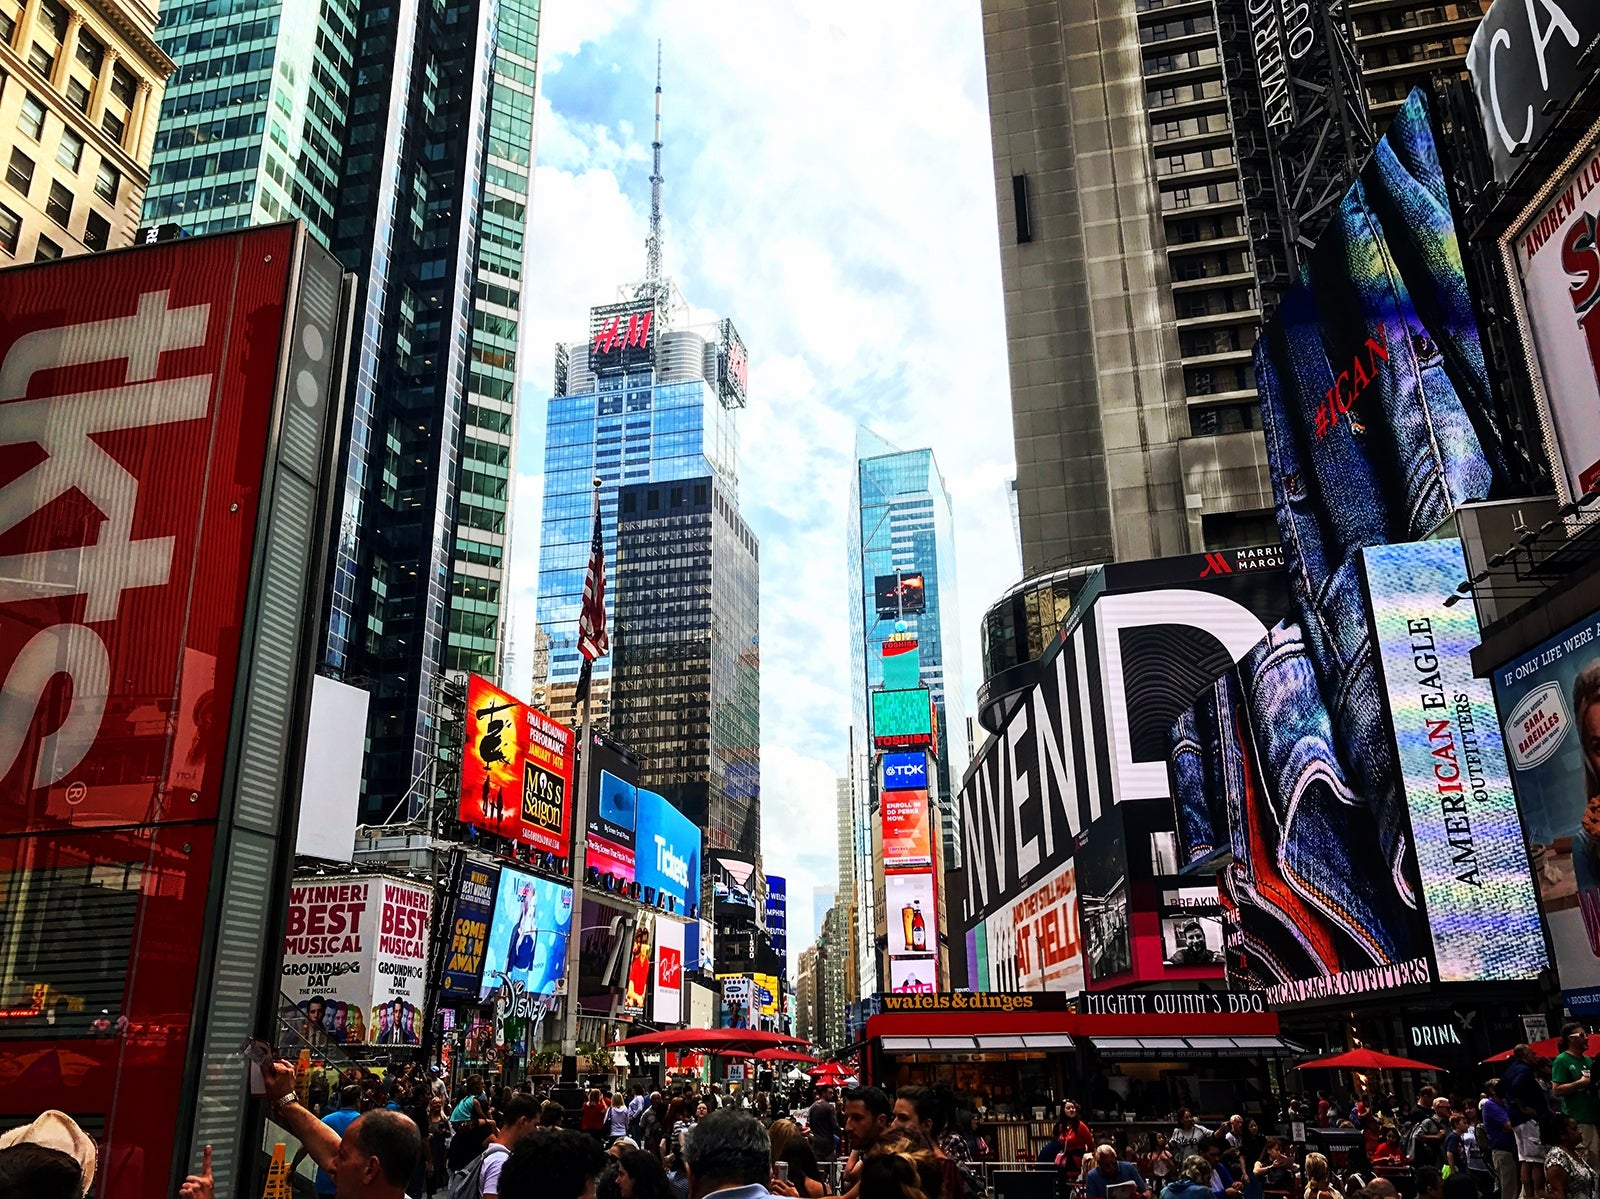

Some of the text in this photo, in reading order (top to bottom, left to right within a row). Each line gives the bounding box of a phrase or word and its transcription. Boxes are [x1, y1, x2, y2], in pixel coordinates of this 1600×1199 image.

[592, 310, 654, 354] H&M
[1314, 322, 1389, 441] #ICAN
[0, 288, 212, 792] tkts
[883, 640, 918, 649] TOSHIBA
[1504, 627, 1594, 687] IF ONLY LIFE WERE
[526, 710, 568, 744] FINAL BROADWAY
[1518, 712, 1560, 754] BAREILLES
[1523, 708, 1545, 733] SARA
[529, 727, 564, 757] PERFORMANCE
[875, 734, 931, 747] TOSHIBA
[1408, 616, 1481, 888] AMERICAN EAGLE
[1454, 693, 1489, 803] OUTFITTERS
[528, 742, 564, 770] JANUARY 14TH
[894, 764, 924, 776] TDK
[524, 792, 561, 828] Saigon
[654, 833, 690, 890] Tickets.
[289, 883, 369, 905] WINNER!
[384, 884, 429, 911] WINNER!
[461, 880, 492, 900] BEST MUSICAL
[285, 902, 366, 936] BEST
[381, 902, 428, 941] BEST
[455, 918, 487, 939] COME
[284, 934, 362, 955] MUSICAL
[379, 935, 424, 959] MUSICAL
[601, 915, 637, 987] 21
[1017, 923, 1032, 978] AT
[282, 961, 360, 977] GROUNDHOG
[378, 961, 423, 979] GROUNDHOG
[447, 951, 481, 975] AWAY
[307, 974, 332, 987] DAY
[311, 987, 337, 995] MUSICAL
[393, 975, 407, 989] DAY
[1304, 974, 1340, 999] EAGLE
[1340, 957, 1430, 995] OUTFITTERS
[396, 988, 410, 997] MUSICAL
[885, 993, 1033, 1011] wafels & dinges
[1086, 993, 1265, 1015] MIGHTY QUINN'S BBQ
